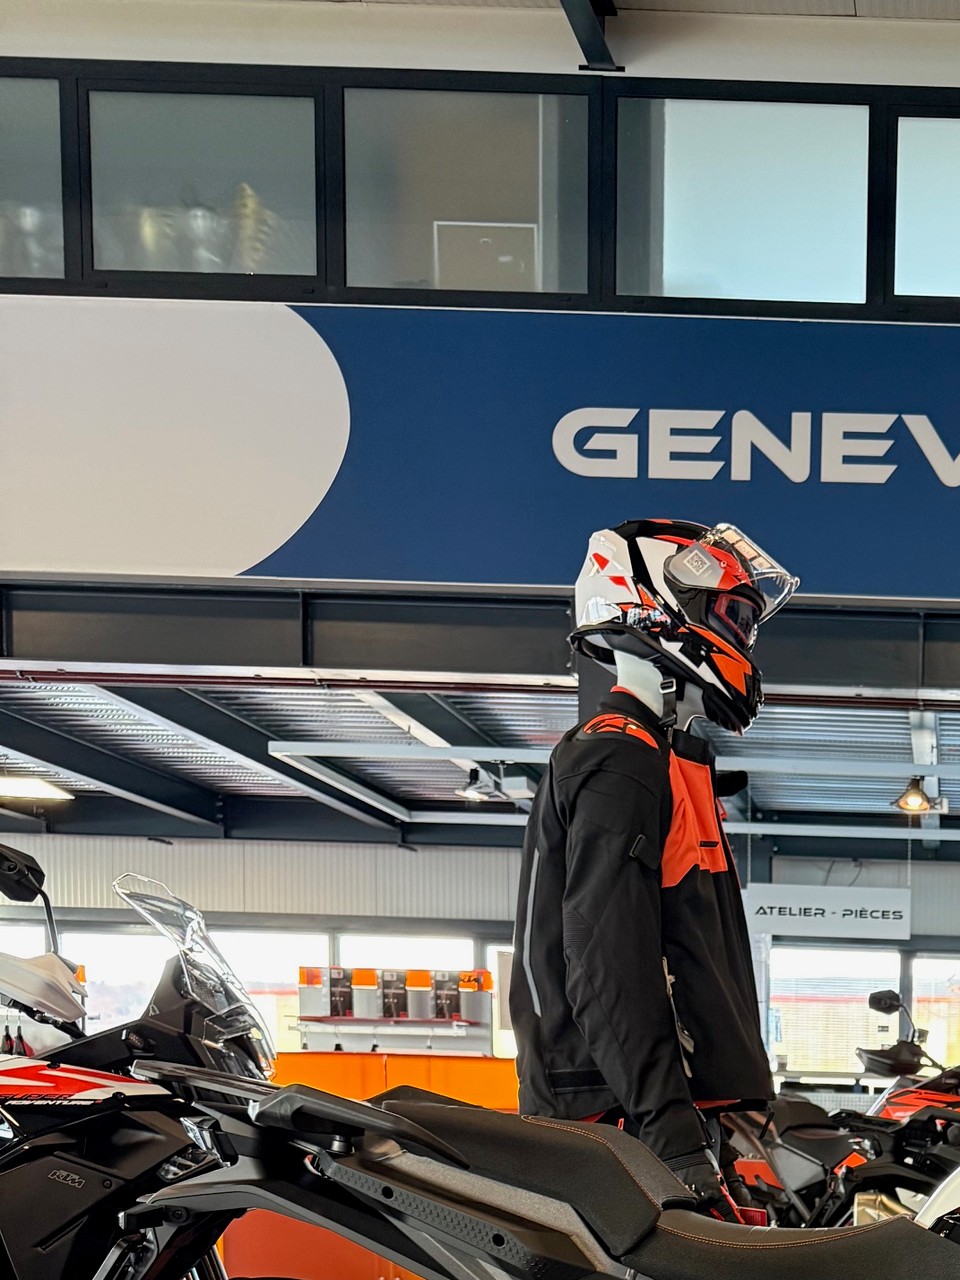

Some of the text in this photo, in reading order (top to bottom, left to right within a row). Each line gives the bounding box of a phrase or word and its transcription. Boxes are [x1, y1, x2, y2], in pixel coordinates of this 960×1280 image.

[755, 906, 826, 918] ATELIER
[842, 907, 904, 921] PIÈCES
[48, 1169, 86, 1188] KTM
